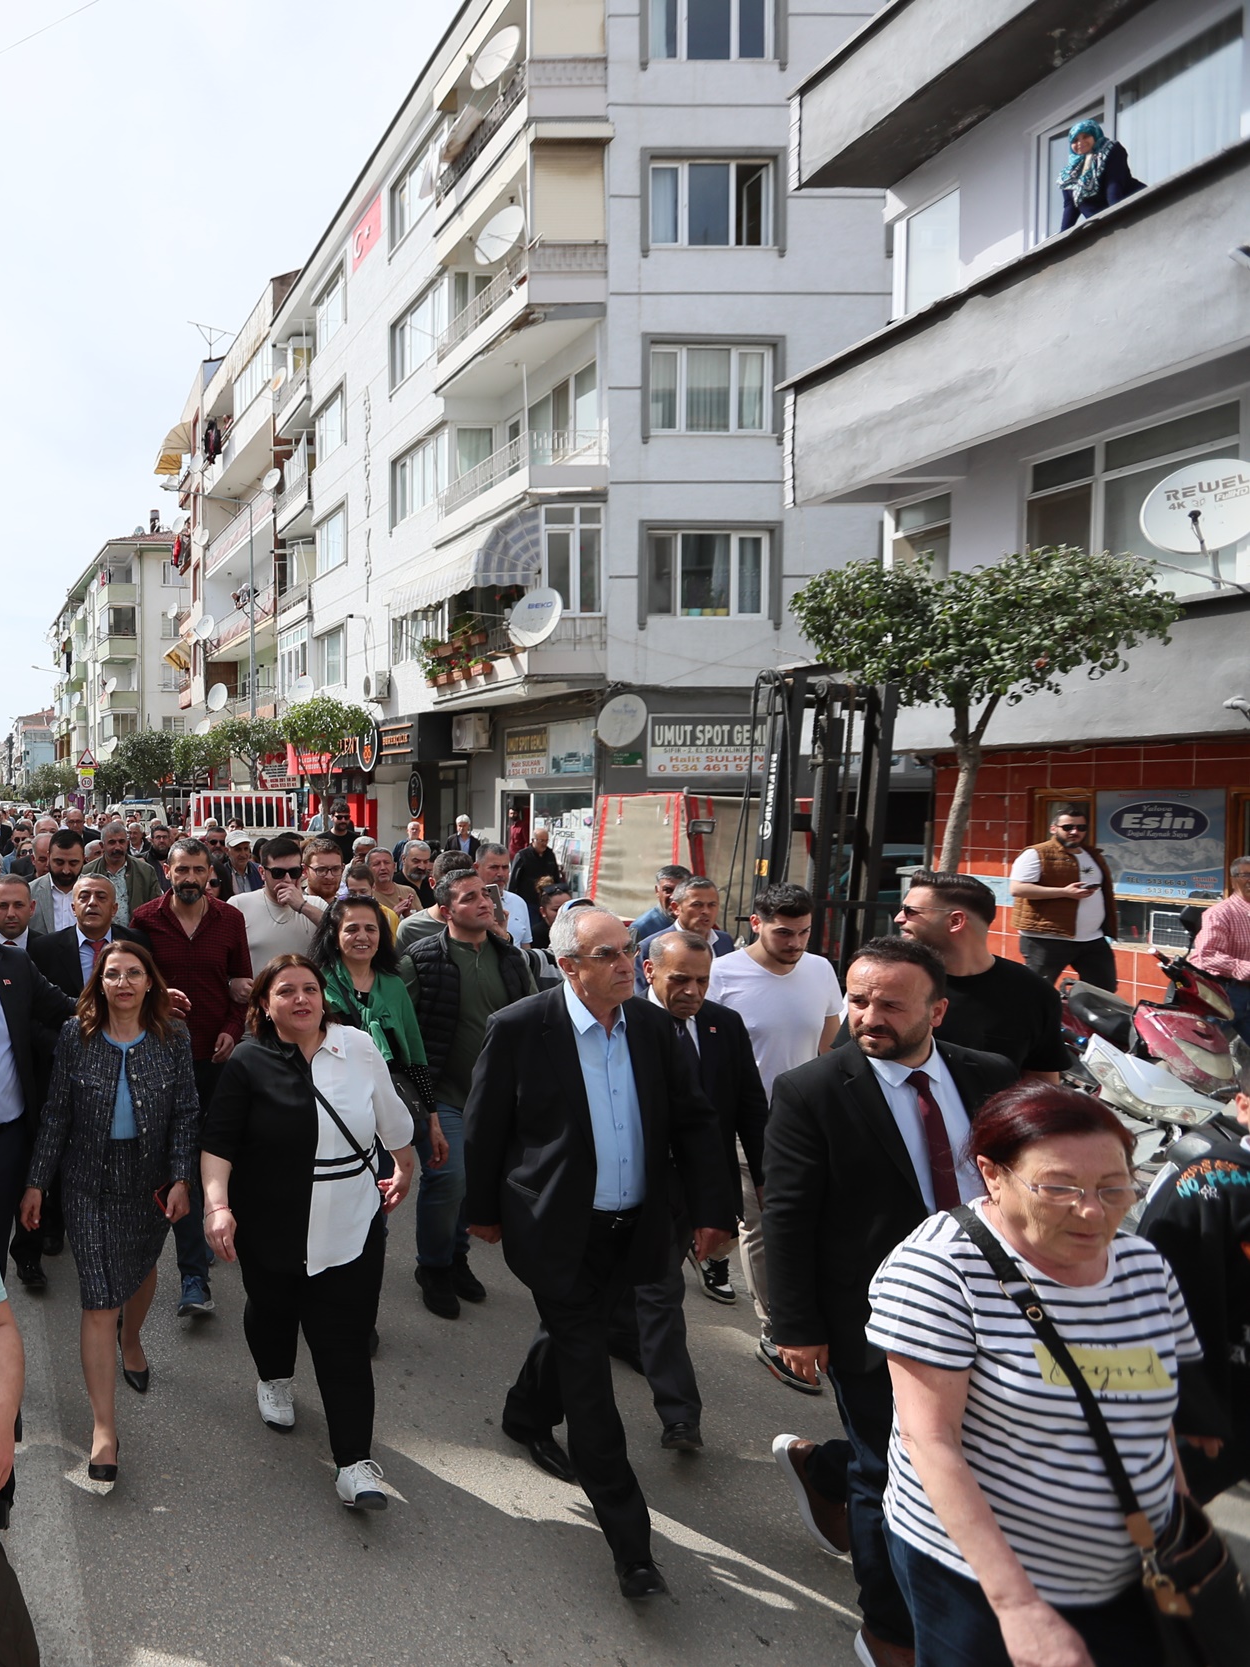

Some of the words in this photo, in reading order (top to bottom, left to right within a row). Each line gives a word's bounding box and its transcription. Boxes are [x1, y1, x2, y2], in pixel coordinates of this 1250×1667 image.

[1168, 501, 1187, 511] 4K
[527, 601, 553, 609] BEKO
[654, 725, 693, 746] UMUT
[695, 725, 730, 746] SPOT
[669, 755, 702, 763] Halit
[657, 764, 667, 772] 0
[671, 764, 698, 772] 534
[703, 764, 729, 772] 461
[1120, 812, 1196, 830] Esin
[1126, 829, 1146, 838] Doğal
[1146, 830, 1171, 839] Kaynak
[1172, 830, 1188, 839] Suyu
[1126, 876, 1140, 884] TEL
[1176, 1177, 1199, 1199] NO
